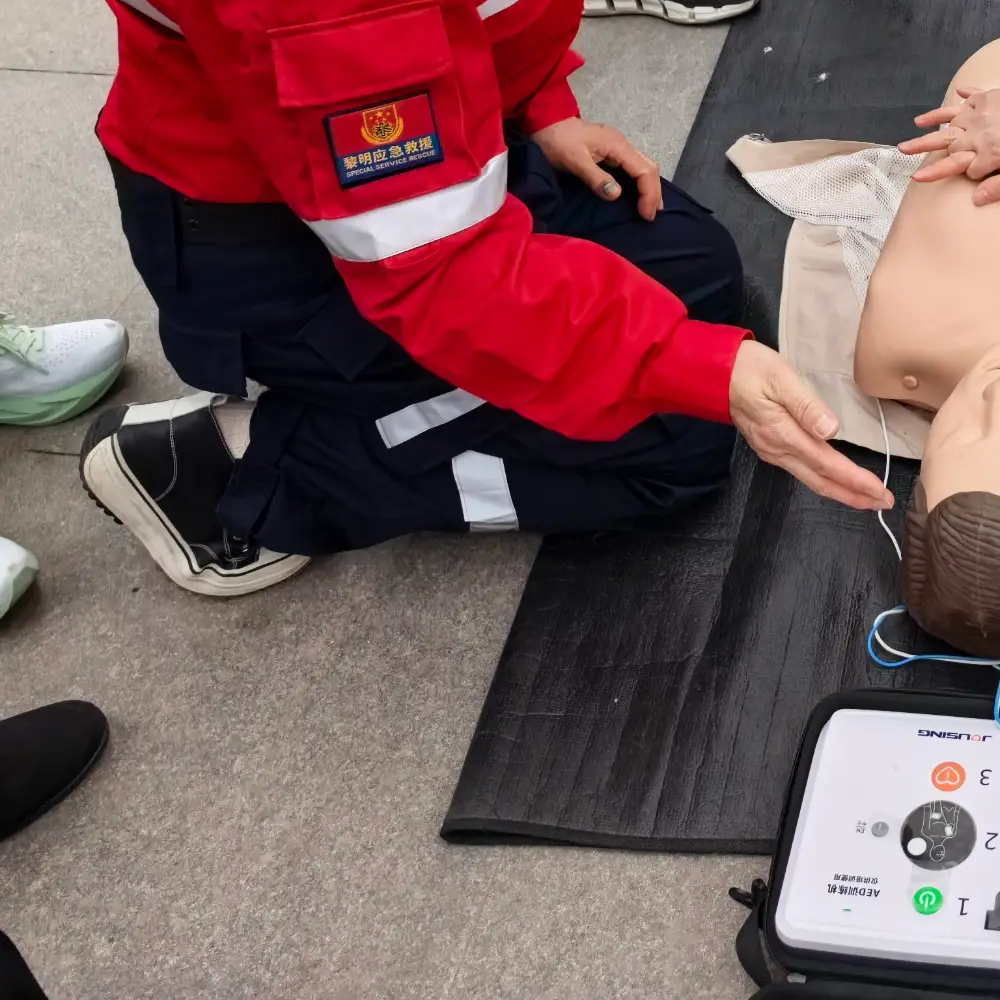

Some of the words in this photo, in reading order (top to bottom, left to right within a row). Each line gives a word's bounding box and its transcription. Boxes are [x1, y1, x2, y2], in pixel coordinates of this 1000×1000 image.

[343, 136, 434, 170] 黎明应急救援
[346, 165, 375, 178] SPECIAL
[375, 158, 408, 170] SERVICE
[408, 149, 436, 161] RESCUE
[979, 768, 993, 786] 3
[984, 832, 999, 850] 2
[827, 883, 881, 898] AED训练机
[957, 897, 970, 916] 1
